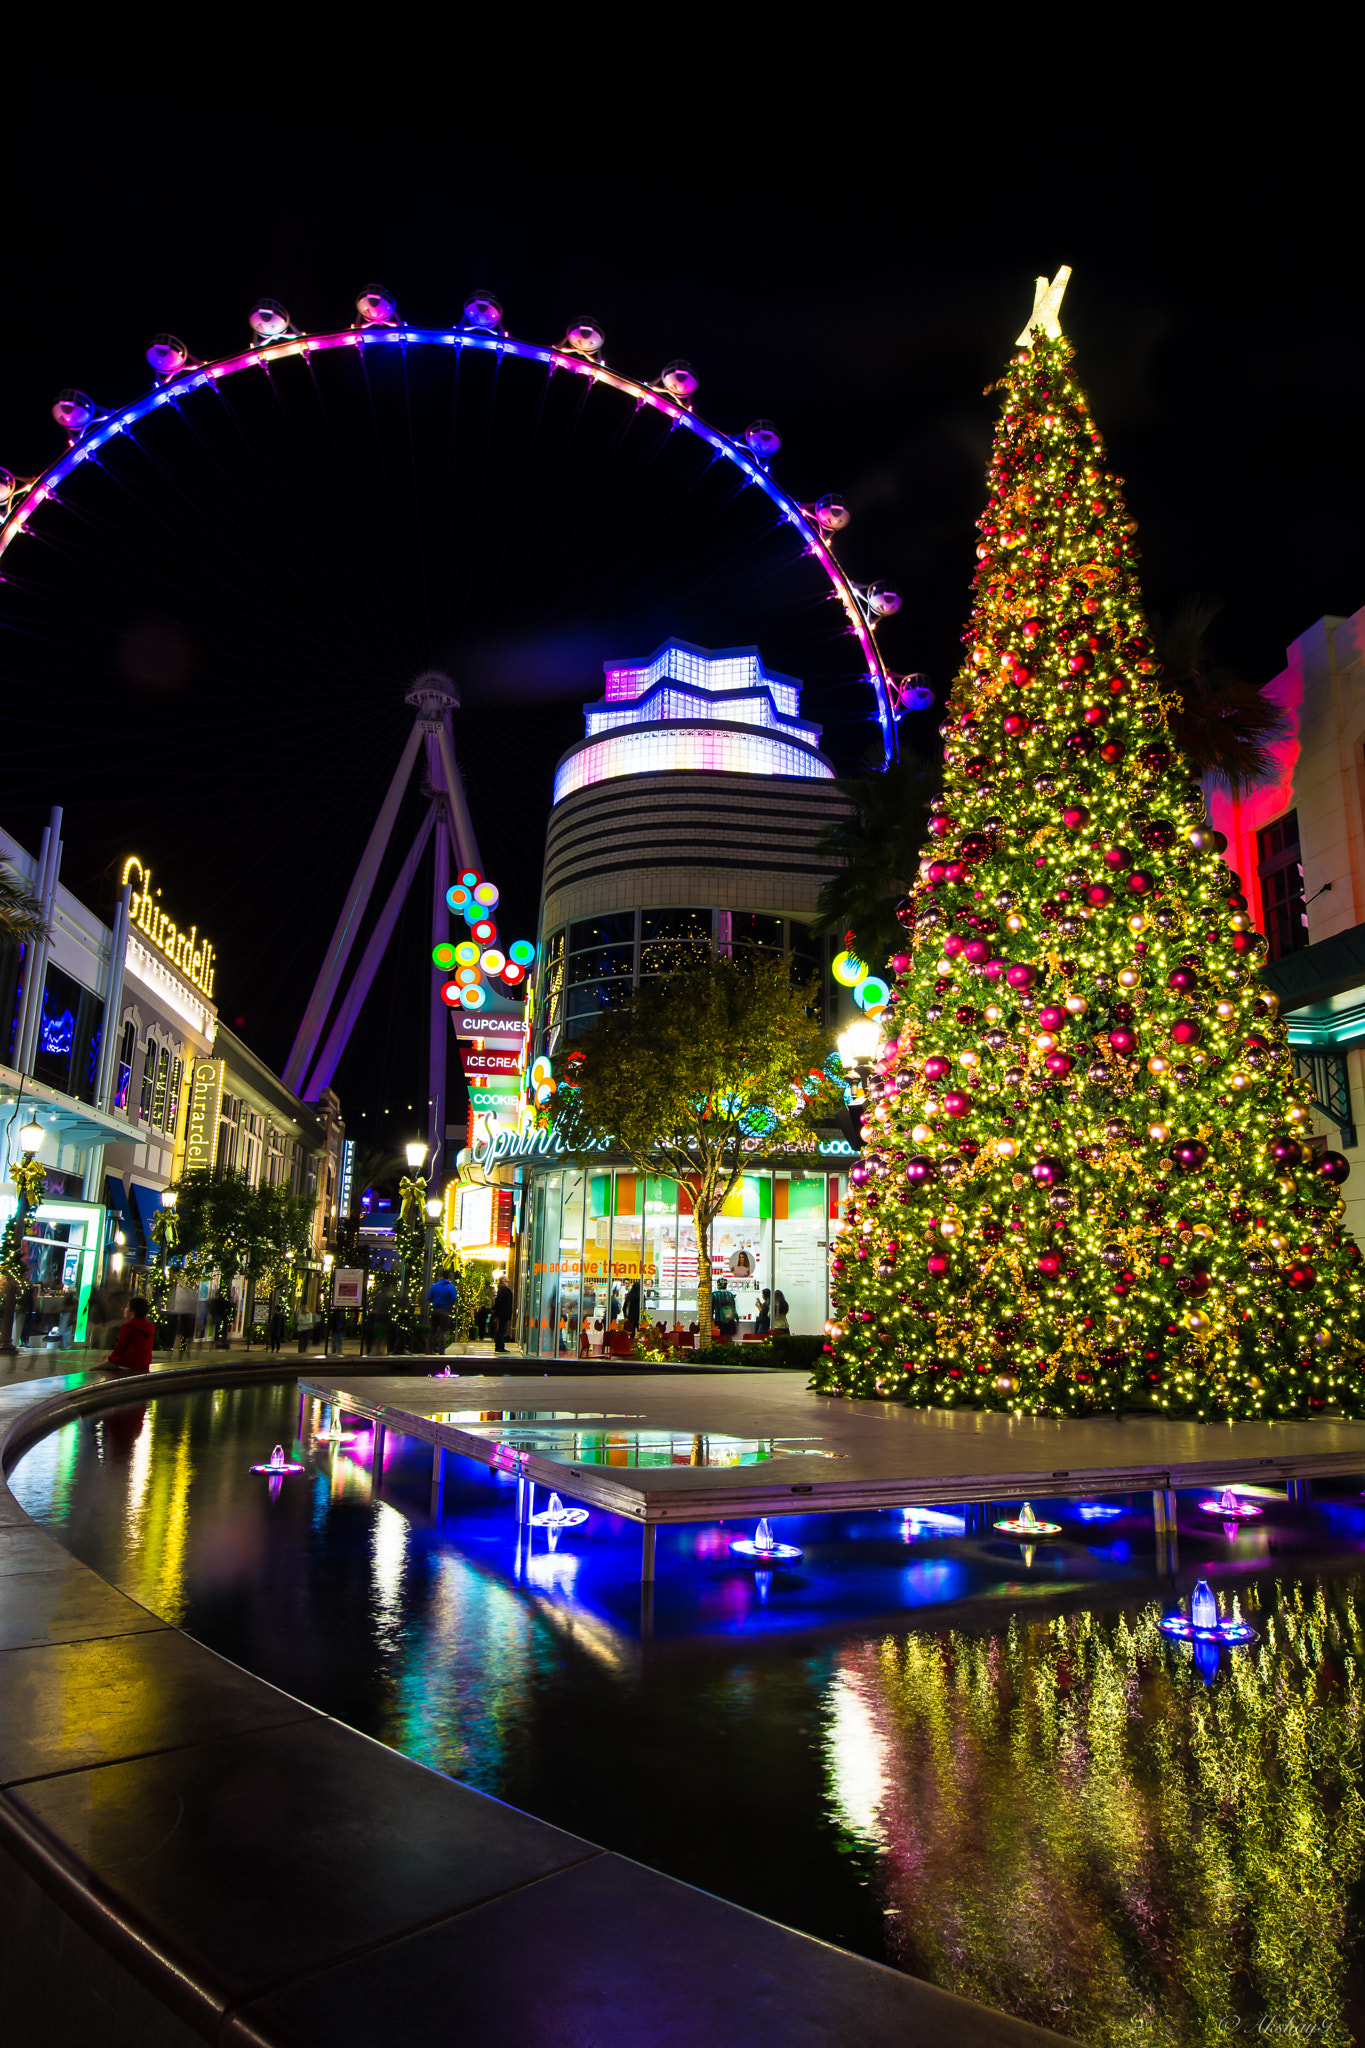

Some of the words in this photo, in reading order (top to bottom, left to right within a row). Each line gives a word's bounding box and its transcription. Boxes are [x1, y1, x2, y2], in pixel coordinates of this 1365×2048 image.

[121, 856, 217, 999] Ghirardelli
[462, 1018, 529, 1032] CUPCAKES
[466, 1056, 486, 1067] ICE
[486, 1057, 520, 1068] CREA
[186, 1064, 216, 1176] Ghirardell
[345, 1141, 355, 1173] Yard
[342, 1175, 352, 1216] House
[533, 1259, 548, 1276] give
[549, 1260, 568, 1273] and
[571, 1259, 598, 1276] give
[602, 1260, 657, 1275] thanks
